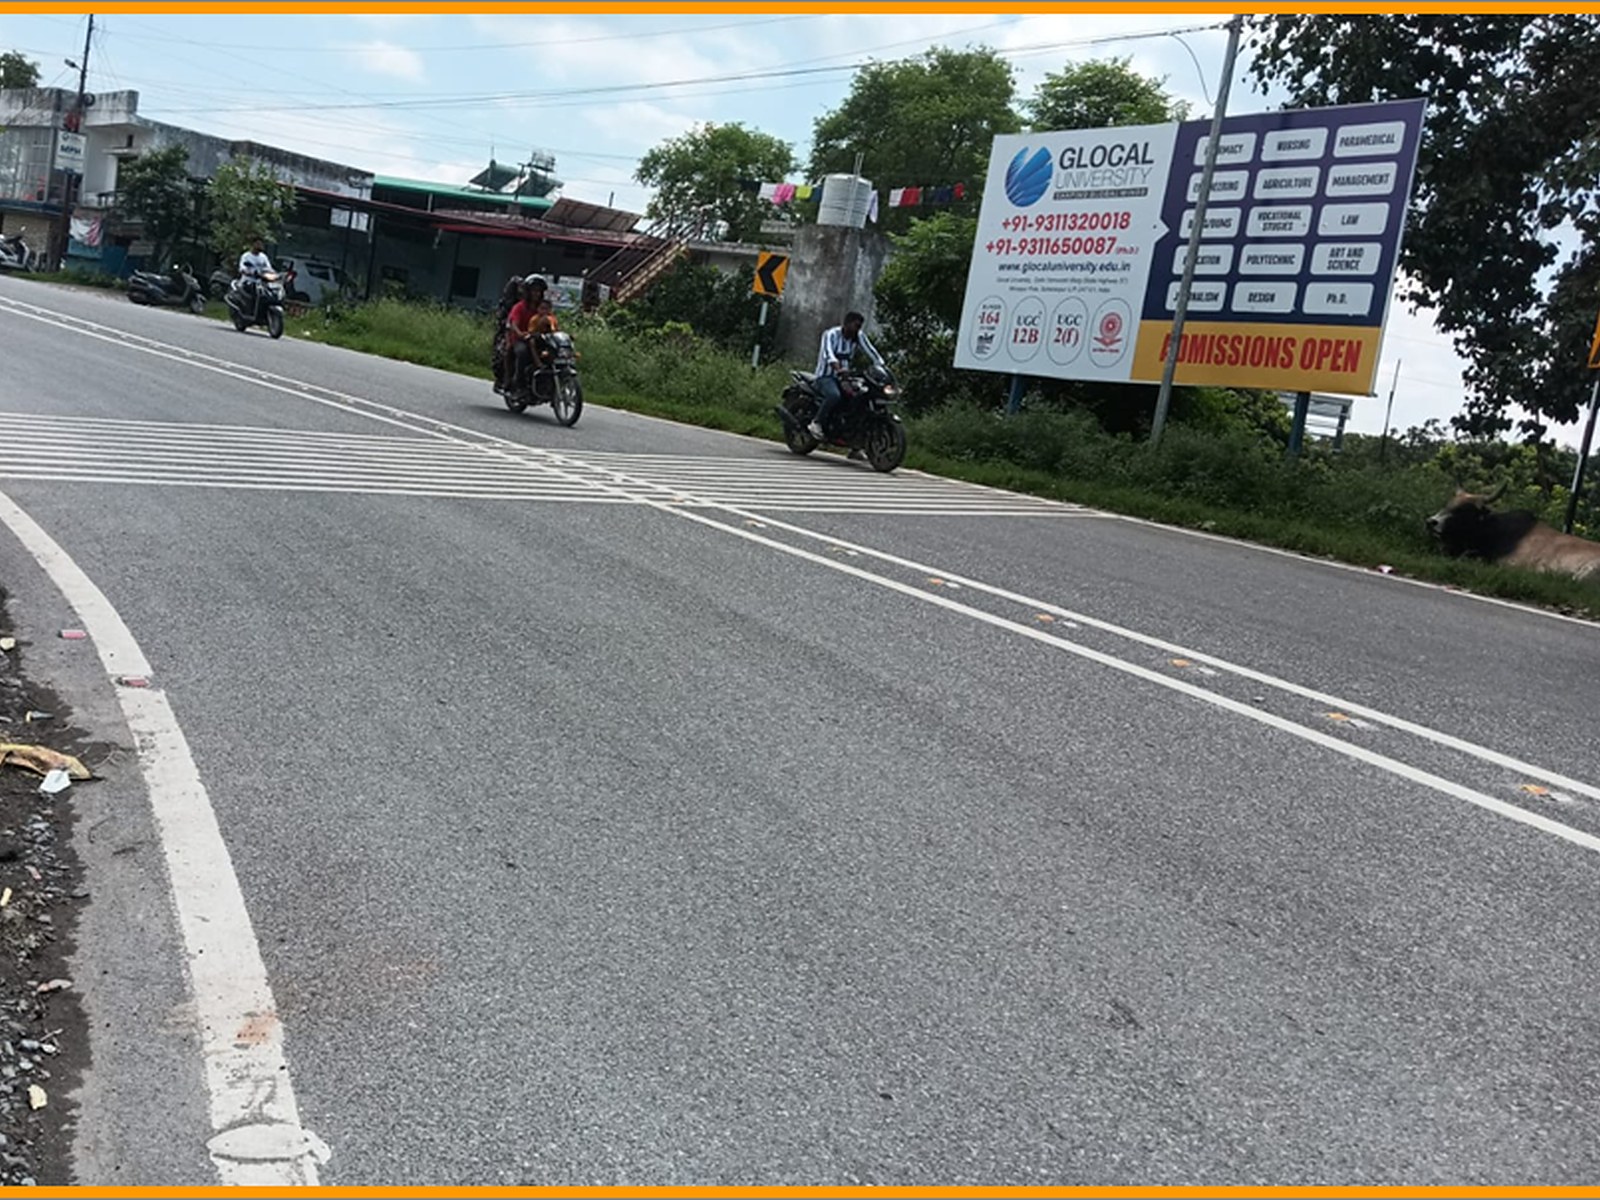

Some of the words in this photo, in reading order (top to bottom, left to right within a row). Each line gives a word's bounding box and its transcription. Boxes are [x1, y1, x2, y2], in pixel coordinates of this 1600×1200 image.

[1340, 133, 1396, 147] PARAMEDICAL
[1059, 141, 1155, 170] GLOCAL
[1055, 167, 1152, 190] UNIVERSITY
[1262, 177, 1313, 190] AGRICULTURE
[1331, 173, 1391, 187] MANAGEMENT
[1002, 212, 1132, 232] +91-9311320018
[1257, 211, 1302, 221] VOCATIONAL
[1341, 214, 1359, 226] LAW
[1262, 221, 1294, 231] STUDIES
[985, 237, 1117, 256] +91-9311650087
[1328, 247, 1346, 258] ART
[1347, 247, 1365, 258] AND
[1246, 254, 1296, 265] POLYTECHNIC
[1326, 259, 1361, 271] SCIENCE
[998, 262, 1131, 274] www.glocaluniversity.edu.in
[1016, 315, 1040, 327] UGC
[1057, 314, 1083, 326] UGC
[1013, 327, 1039, 344] 12B
[1053, 327, 1080, 347] 2(f)
[1299, 338, 1363, 373] OPEN
